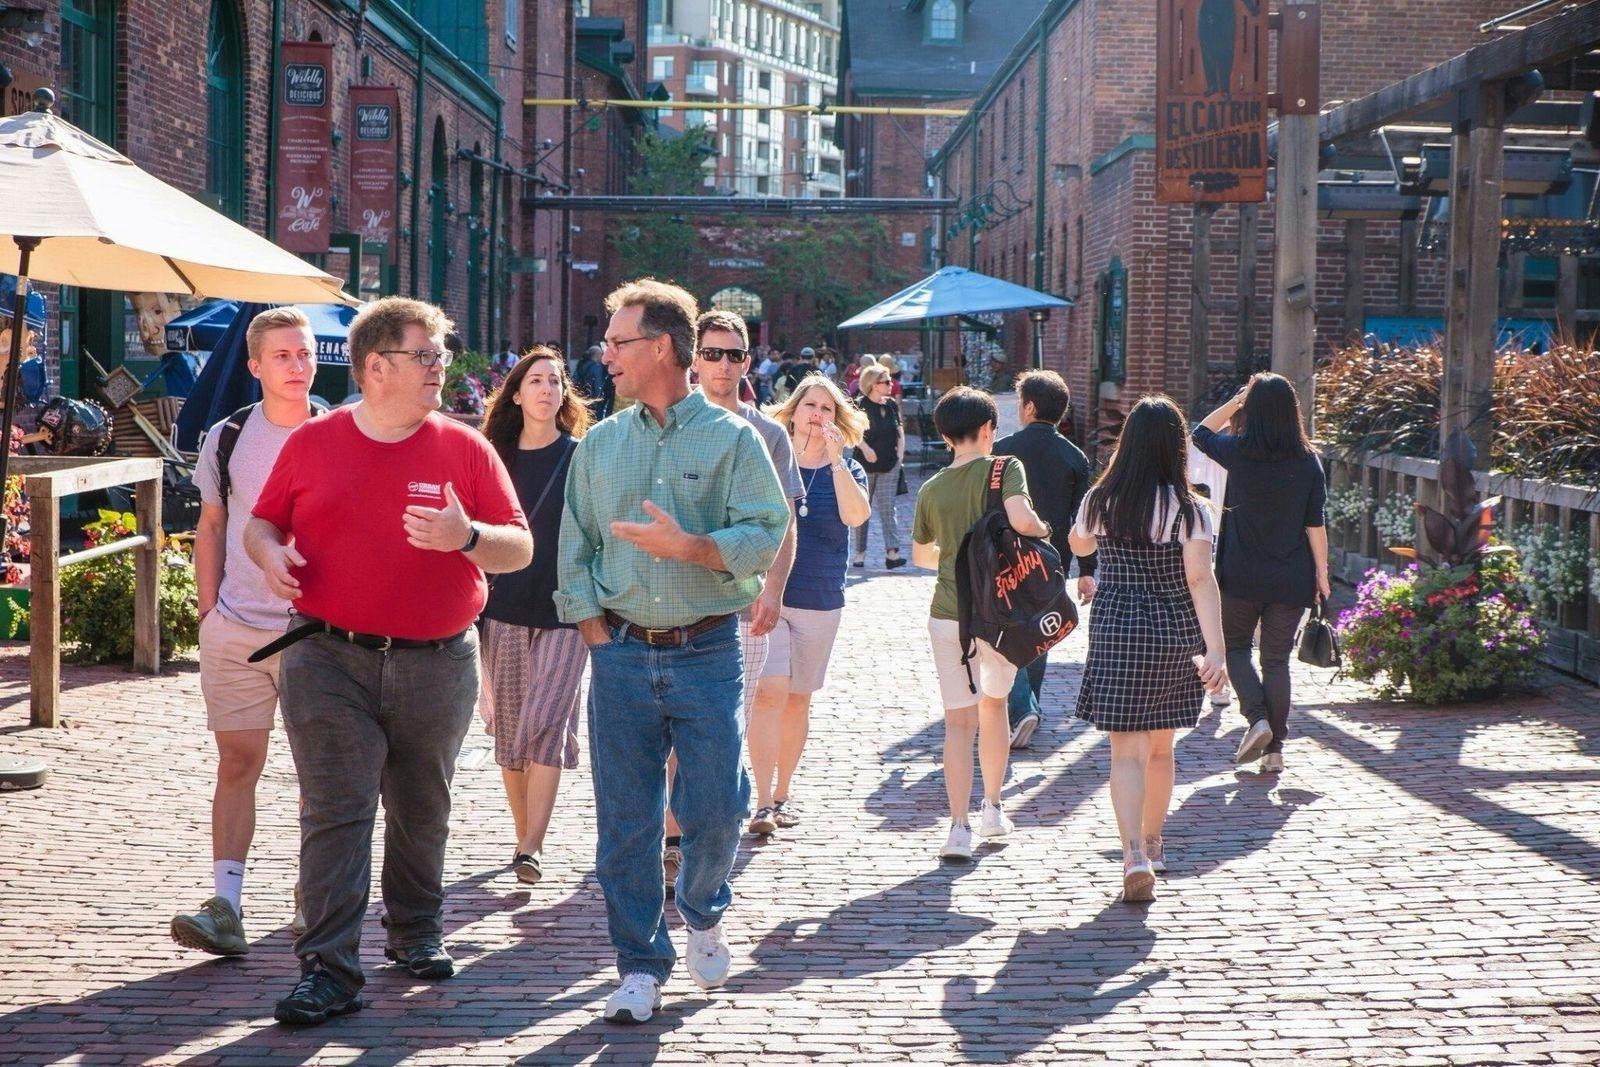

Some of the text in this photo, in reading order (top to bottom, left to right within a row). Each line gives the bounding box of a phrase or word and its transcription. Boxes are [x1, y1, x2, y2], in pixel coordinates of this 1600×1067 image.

[288, 68, 323, 88] Wildly
[290, 90, 320, 99] DELICIOUS
[358, 107, 389, 125] Wildly
